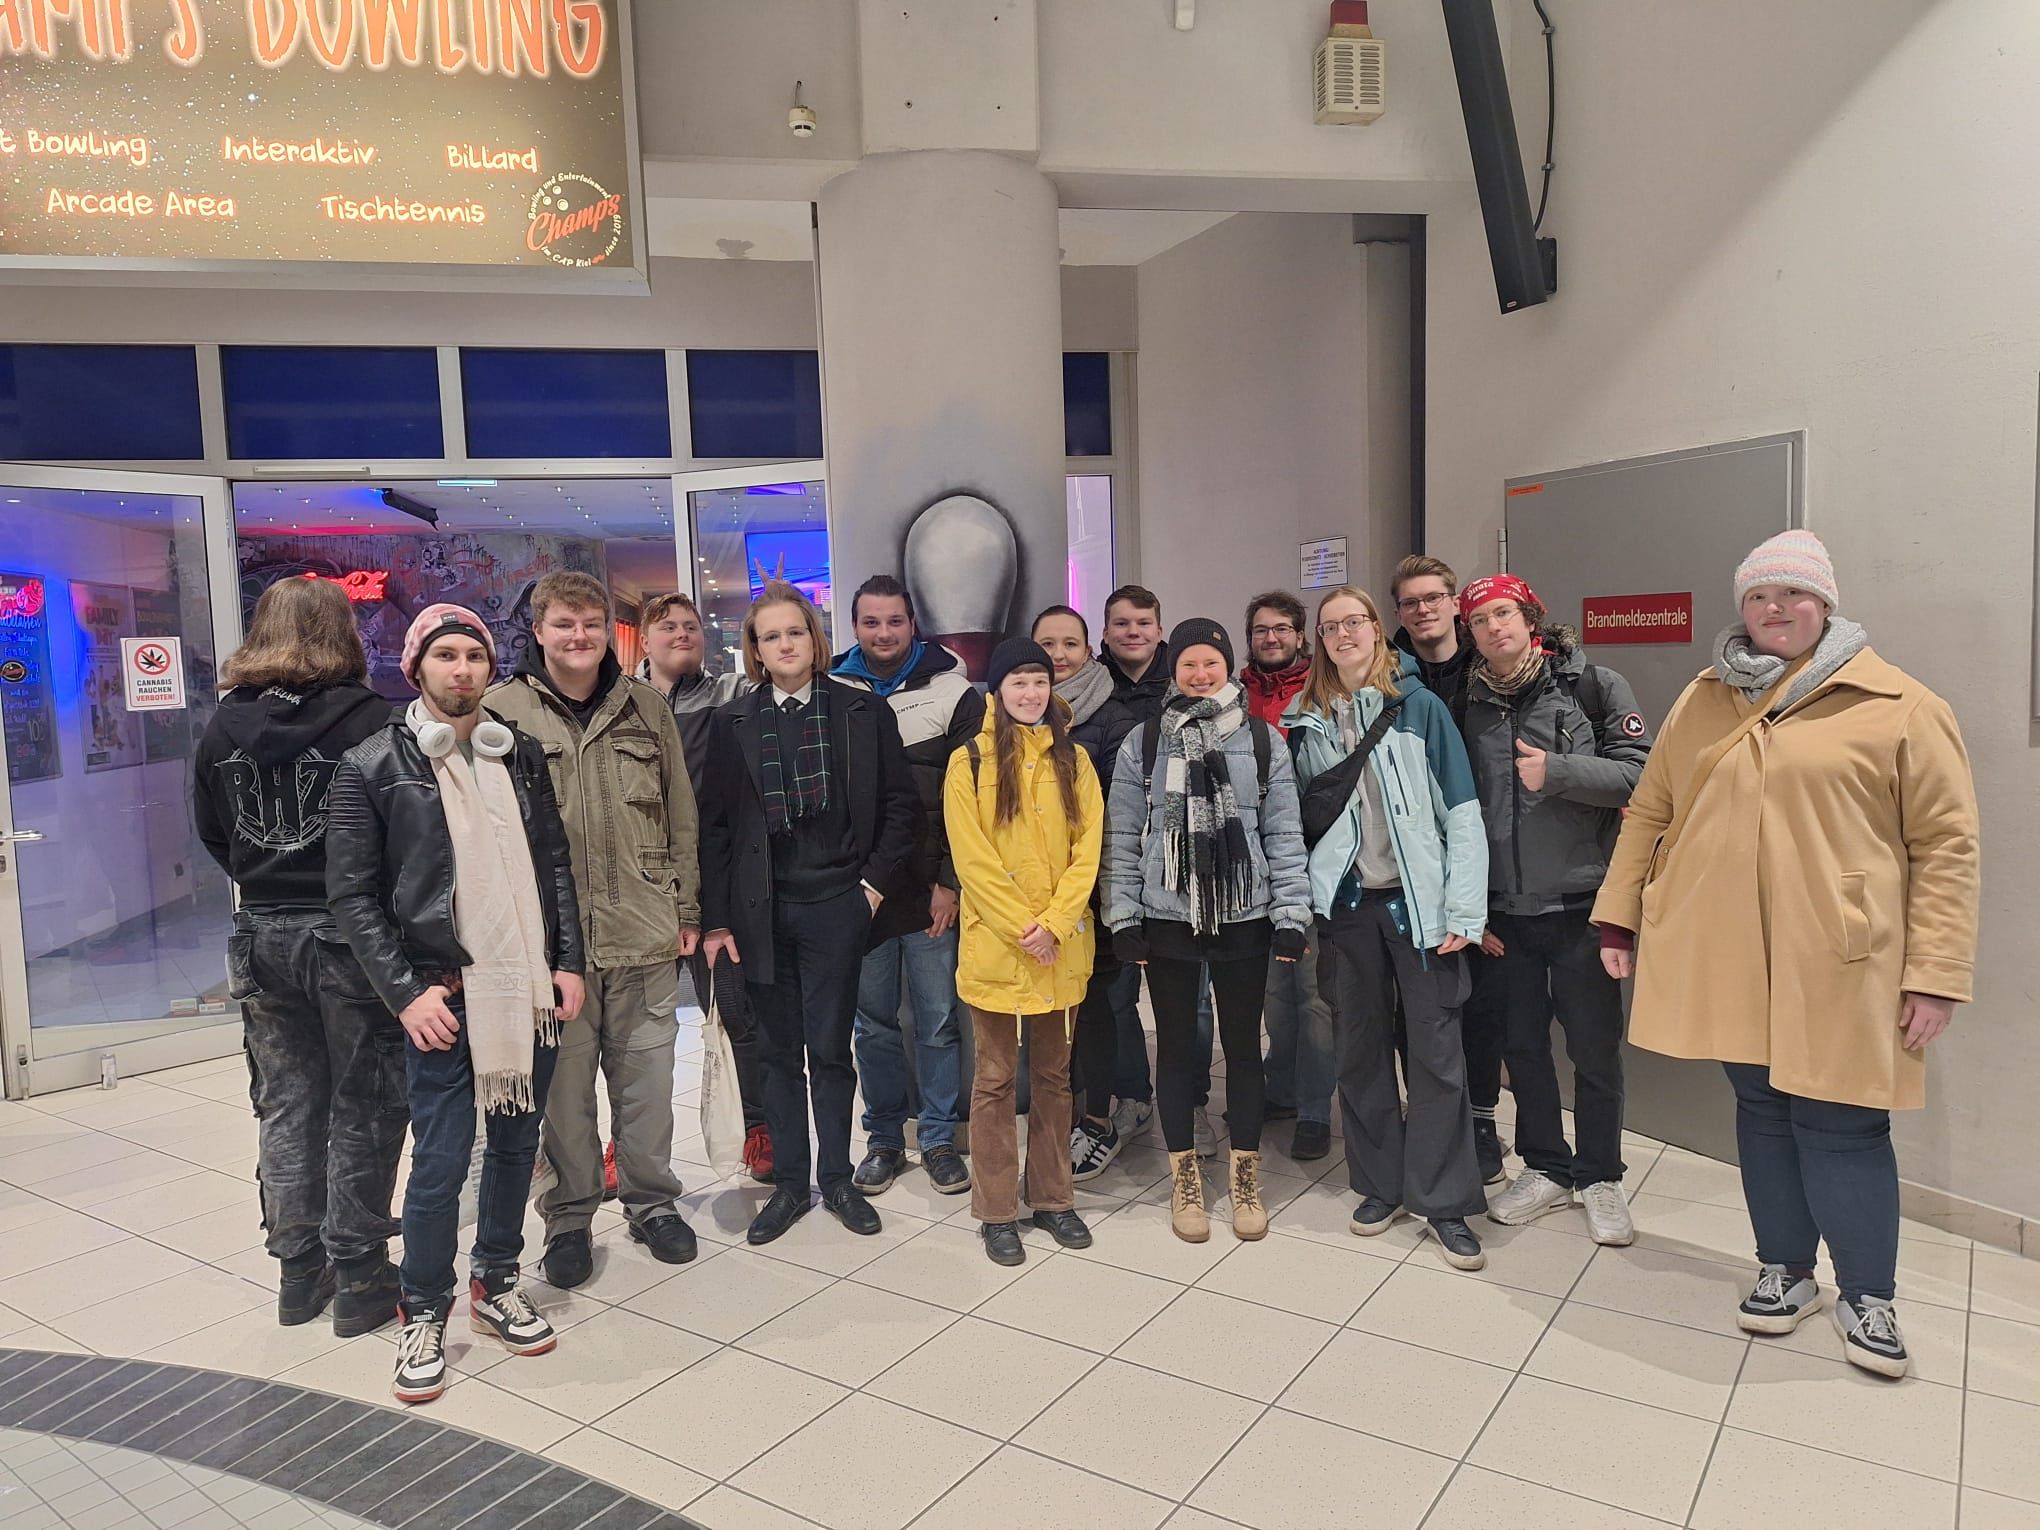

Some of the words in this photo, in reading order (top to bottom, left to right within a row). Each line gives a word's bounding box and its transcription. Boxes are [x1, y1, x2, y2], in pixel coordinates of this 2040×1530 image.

[28, 130, 147, 166] Bowling
[224, 135, 374, 165] Interaktiv
[447, 144, 537, 173] Billard
[48, 187, 153, 216] Arcade
[165, 191, 234, 217] Area
[321, 195, 485, 223] Tischtennis
[526, 193, 621, 251] Champs
[1586, 606, 1688, 629] Brandmeldezentrale
[136, 678, 173, 687] CANNABIS
[138, 686, 172, 694] RAUCHEN
[136, 693, 176, 702] VERBOTEN!
